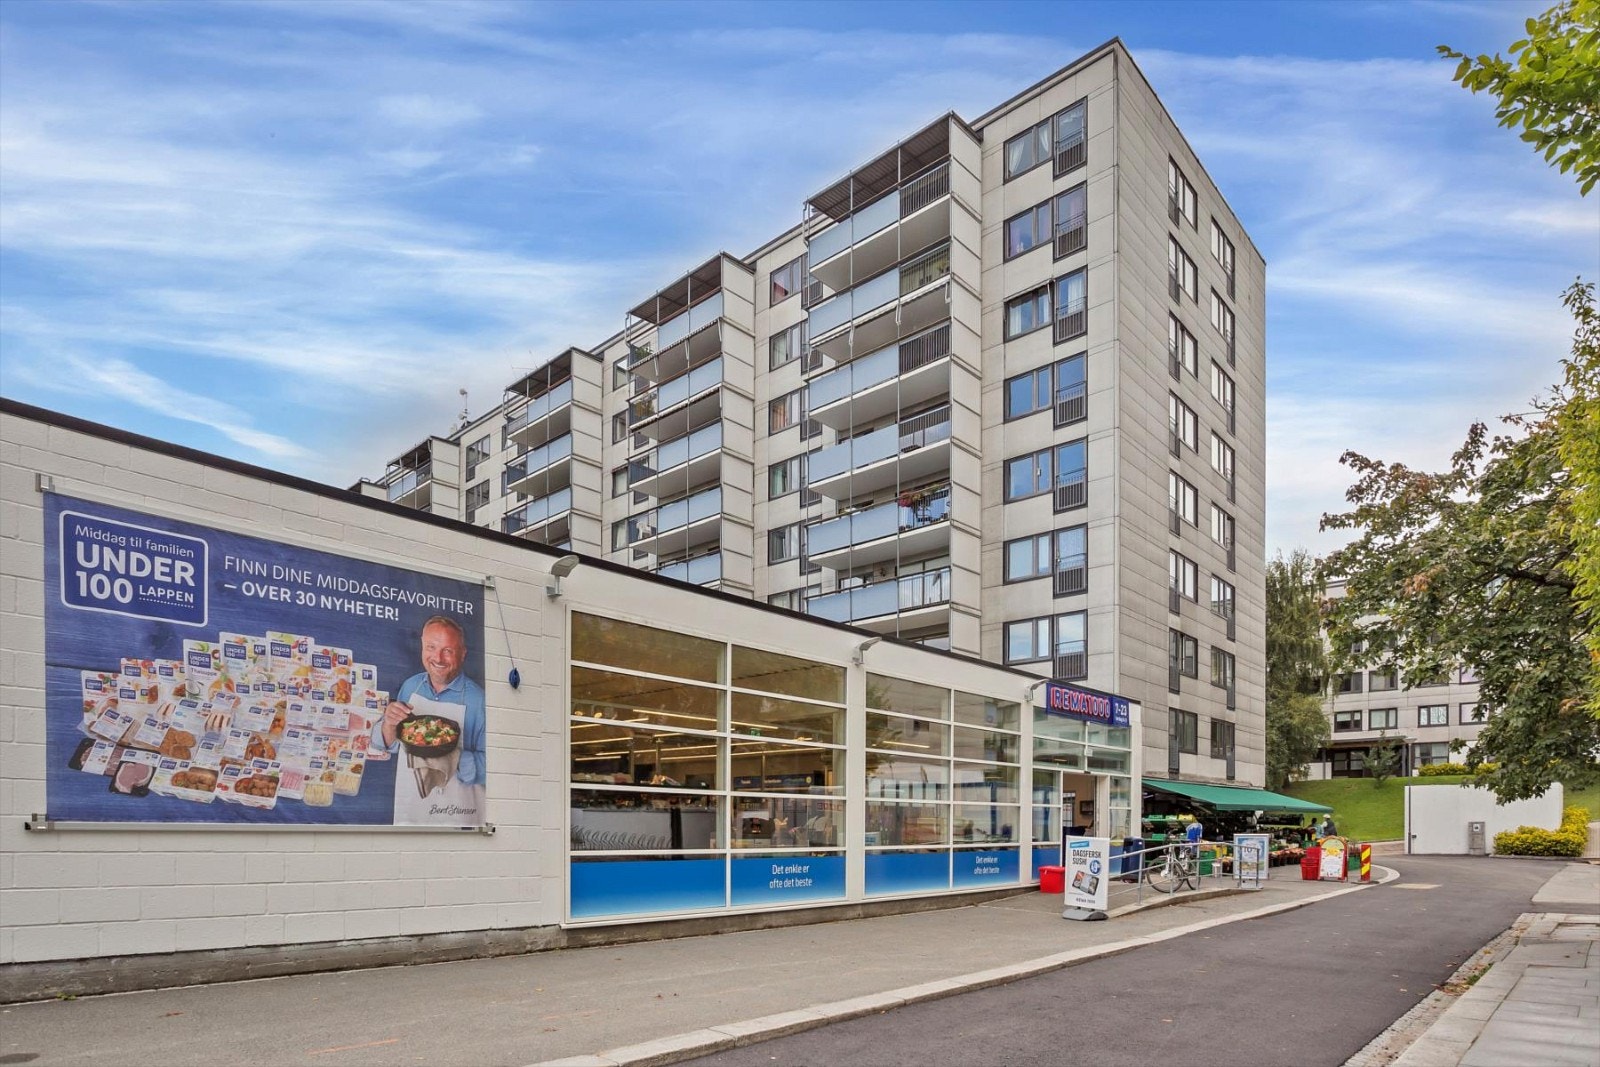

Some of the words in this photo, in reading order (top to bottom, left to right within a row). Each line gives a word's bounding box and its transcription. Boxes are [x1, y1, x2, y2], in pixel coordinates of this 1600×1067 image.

[75, 524, 126, 546] Middag
[130, 536, 142, 548] til
[146, 539, 194, 558] familien
[76, 541, 195, 587] UNDER
[76, 570, 133, 604] 100
[139, 585, 194, 604] LAPPEN
[225, 555, 267, 577] FINN
[273, 565, 312, 585] DINE
[317, 573, 474, 616] MIDDAGSFAVORITTER
[242, 581, 291, 603] OVER
[296, 590, 316, 607] 30
[320, 595, 399, 621] NYHETER!
[1114, 702, 1127, 717] 7-23
[1072, 849, 1102, 859] DAGSFERSK
[1072, 857, 1087, 866] SUSHI
[772, 864, 784, 875] Det
[785, 864, 802, 874] enkle
[802, 865, 810, 873] er
[769, 878, 783, 889] ofte
[783, 878, 795, 888] det
[795, 877, 813, 887] beste
